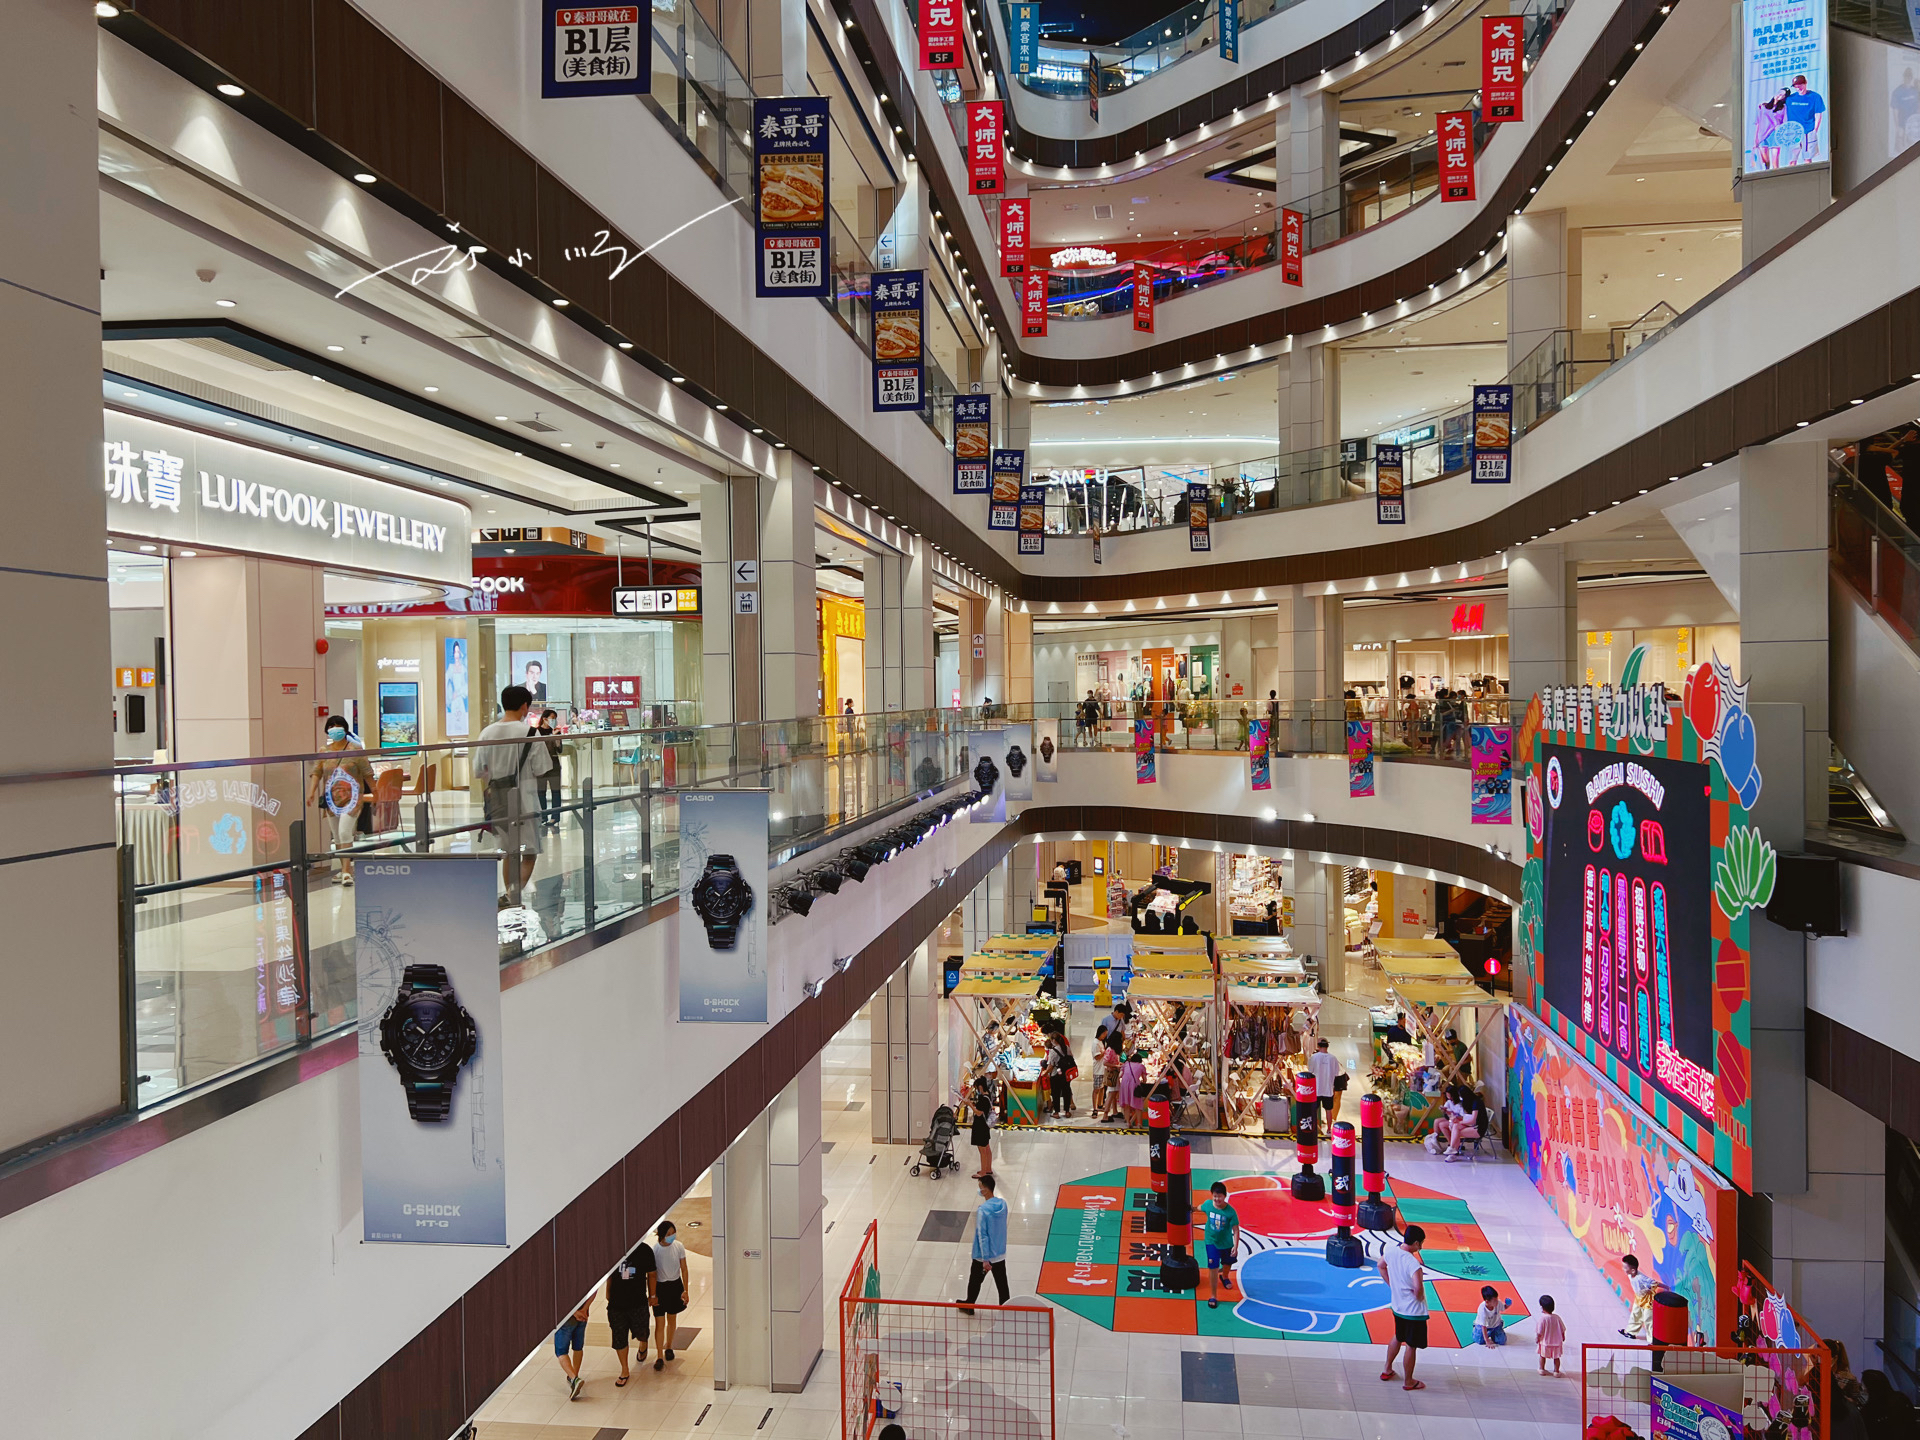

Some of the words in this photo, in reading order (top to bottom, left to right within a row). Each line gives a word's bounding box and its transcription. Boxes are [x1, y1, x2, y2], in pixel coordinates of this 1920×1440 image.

[573, 10, 630, 24] 秦哥哥就在
[929, 0, 953, 26] 兄
[1753, 18, 1813, 37] 热风暑期夏日
[564, 26, 630, 54] B1层
[1758, 29, 1809, 46] 限定大礼包
[935, 53, 948, 62] 5F
[1491, 22, 1515, 82] 大师兄
[562, 56, 630, 77] (美食街)
[1020, 64, 1029, 72] 4F
[1497, 107, 1509, 115] 5F
[759, 114, 823, 139] 秦哥哥
[975, 107, 995, 159] 大师兄
[1444, 117, 1467, 168] 大师兄
[1453, 188, 1463, 196] 5F
[1006, 203, 1024, 247] 大师兄
[1287, 215, 1298, 258] 大师兄
[771, 250, 816, 269] B1层
[770, 270, 816, 284] (美食街)
[875, 282, 919, 301] 秦哥哥
[1028, 274, 1042, 312] 大师兄
[1138, 269, 1150, 307] 大师兄
[883, 378, 915, 391] B1层
[882, 392, 915, 403] (美食街)
[1476, 393, 1509, 405] 秦哥哥
[956, 402, 987, 416] 秦哥哥
[995, 456, 1021, 467] 秦哥哥
[1479, 461, 1504, 470] B1层
[961, 471, 983, 480] B1层
[1021, 491, 1043, 500] 秦哥哥
[199, 470, 329, 531] LUKFOOK
[331, 501, 447, 552] JEWELLERY
[1383, 505, 1400, 513] B1层
[471, 576, 525, 592] FOOK
[661, 592, 672, 609] P
[678, 592, 696, 600] B2F
[1451, 603, 1485, 633] H&M
[141, 671, 155, 683] 1F
[592, 680, 634, 694] 周大福
[1542, 685, 1592, 735] 泰度青春
[1598, 682, 1668, 741] 拳力以赴
[1585, 762, 1624, 805] BANZAI
[1626, 761, 1665, 811] SUSHI
[364, 865, 411, 875] CASIO
[410, 992, 442, 1000] G-SHOCK
[704, 998, 740, 1006] G-SHOCK
[1547, 1093, 1600, 1151] 泰度青春
[1576, 1151, 1643, 1217] 拳力以赴
[403, 1204, 461, 1216] G-SHOCK
